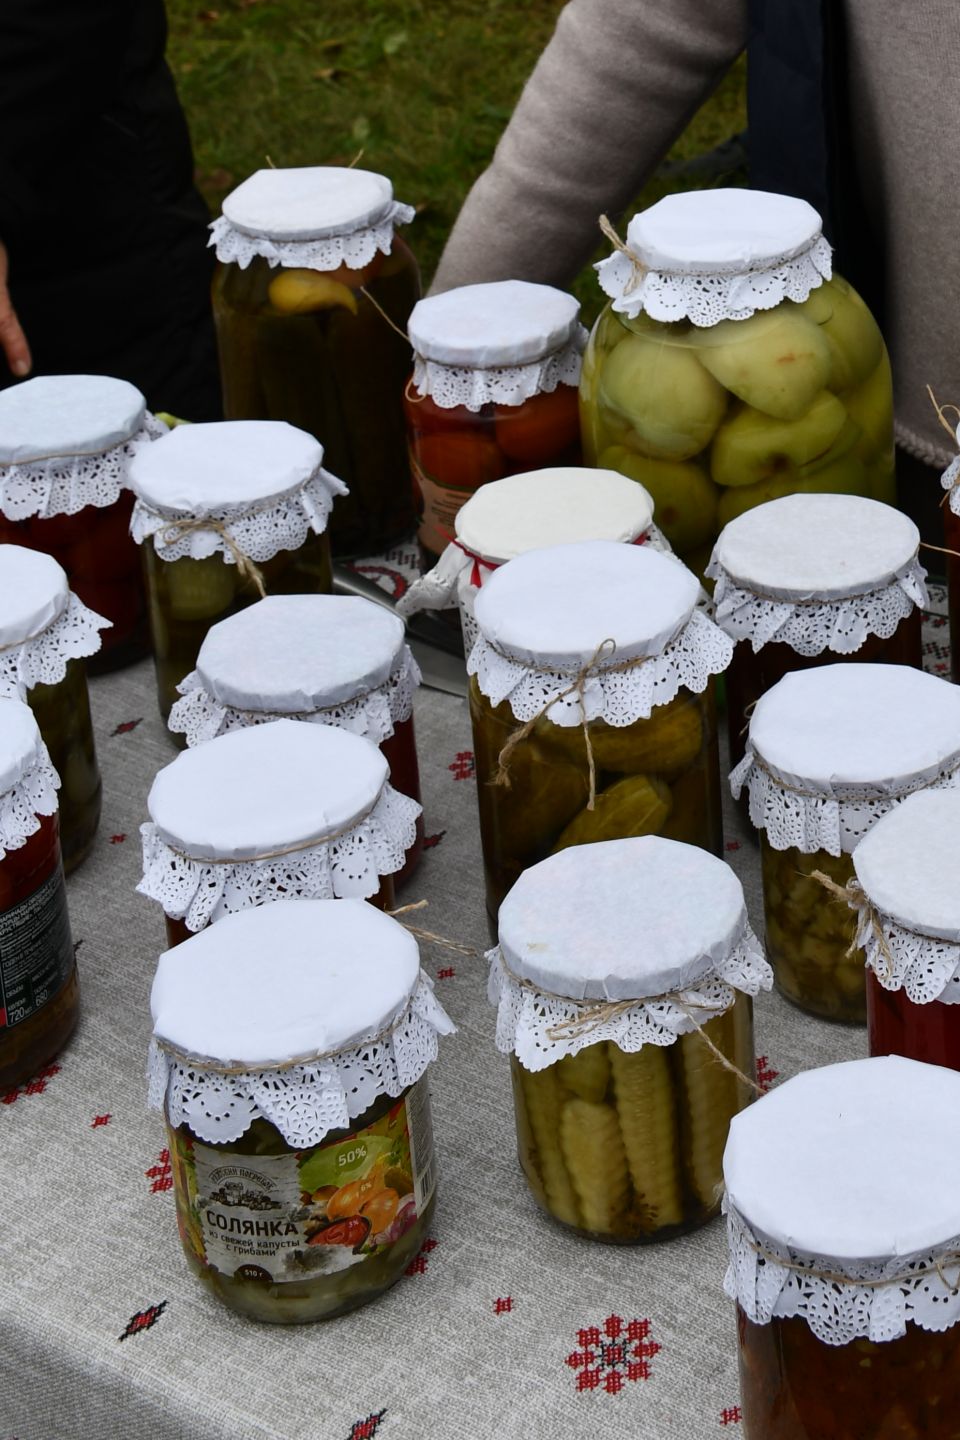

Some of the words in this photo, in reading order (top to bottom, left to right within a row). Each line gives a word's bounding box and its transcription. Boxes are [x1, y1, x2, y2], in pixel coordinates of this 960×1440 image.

[8, 1007, 25, 1023] 720
[338, 1145, 367, 1166] 50%
[206, 1210, 299, 1237] СОЛЯНКА
[209, 1231, 218, 1239] из
[221, 1234, 253, 1247] свежей
[257, 1240, 300, 1251] капусты
[233, 1246, 276, 1257] грибами
[244, 1268, 258, 1277] 510
